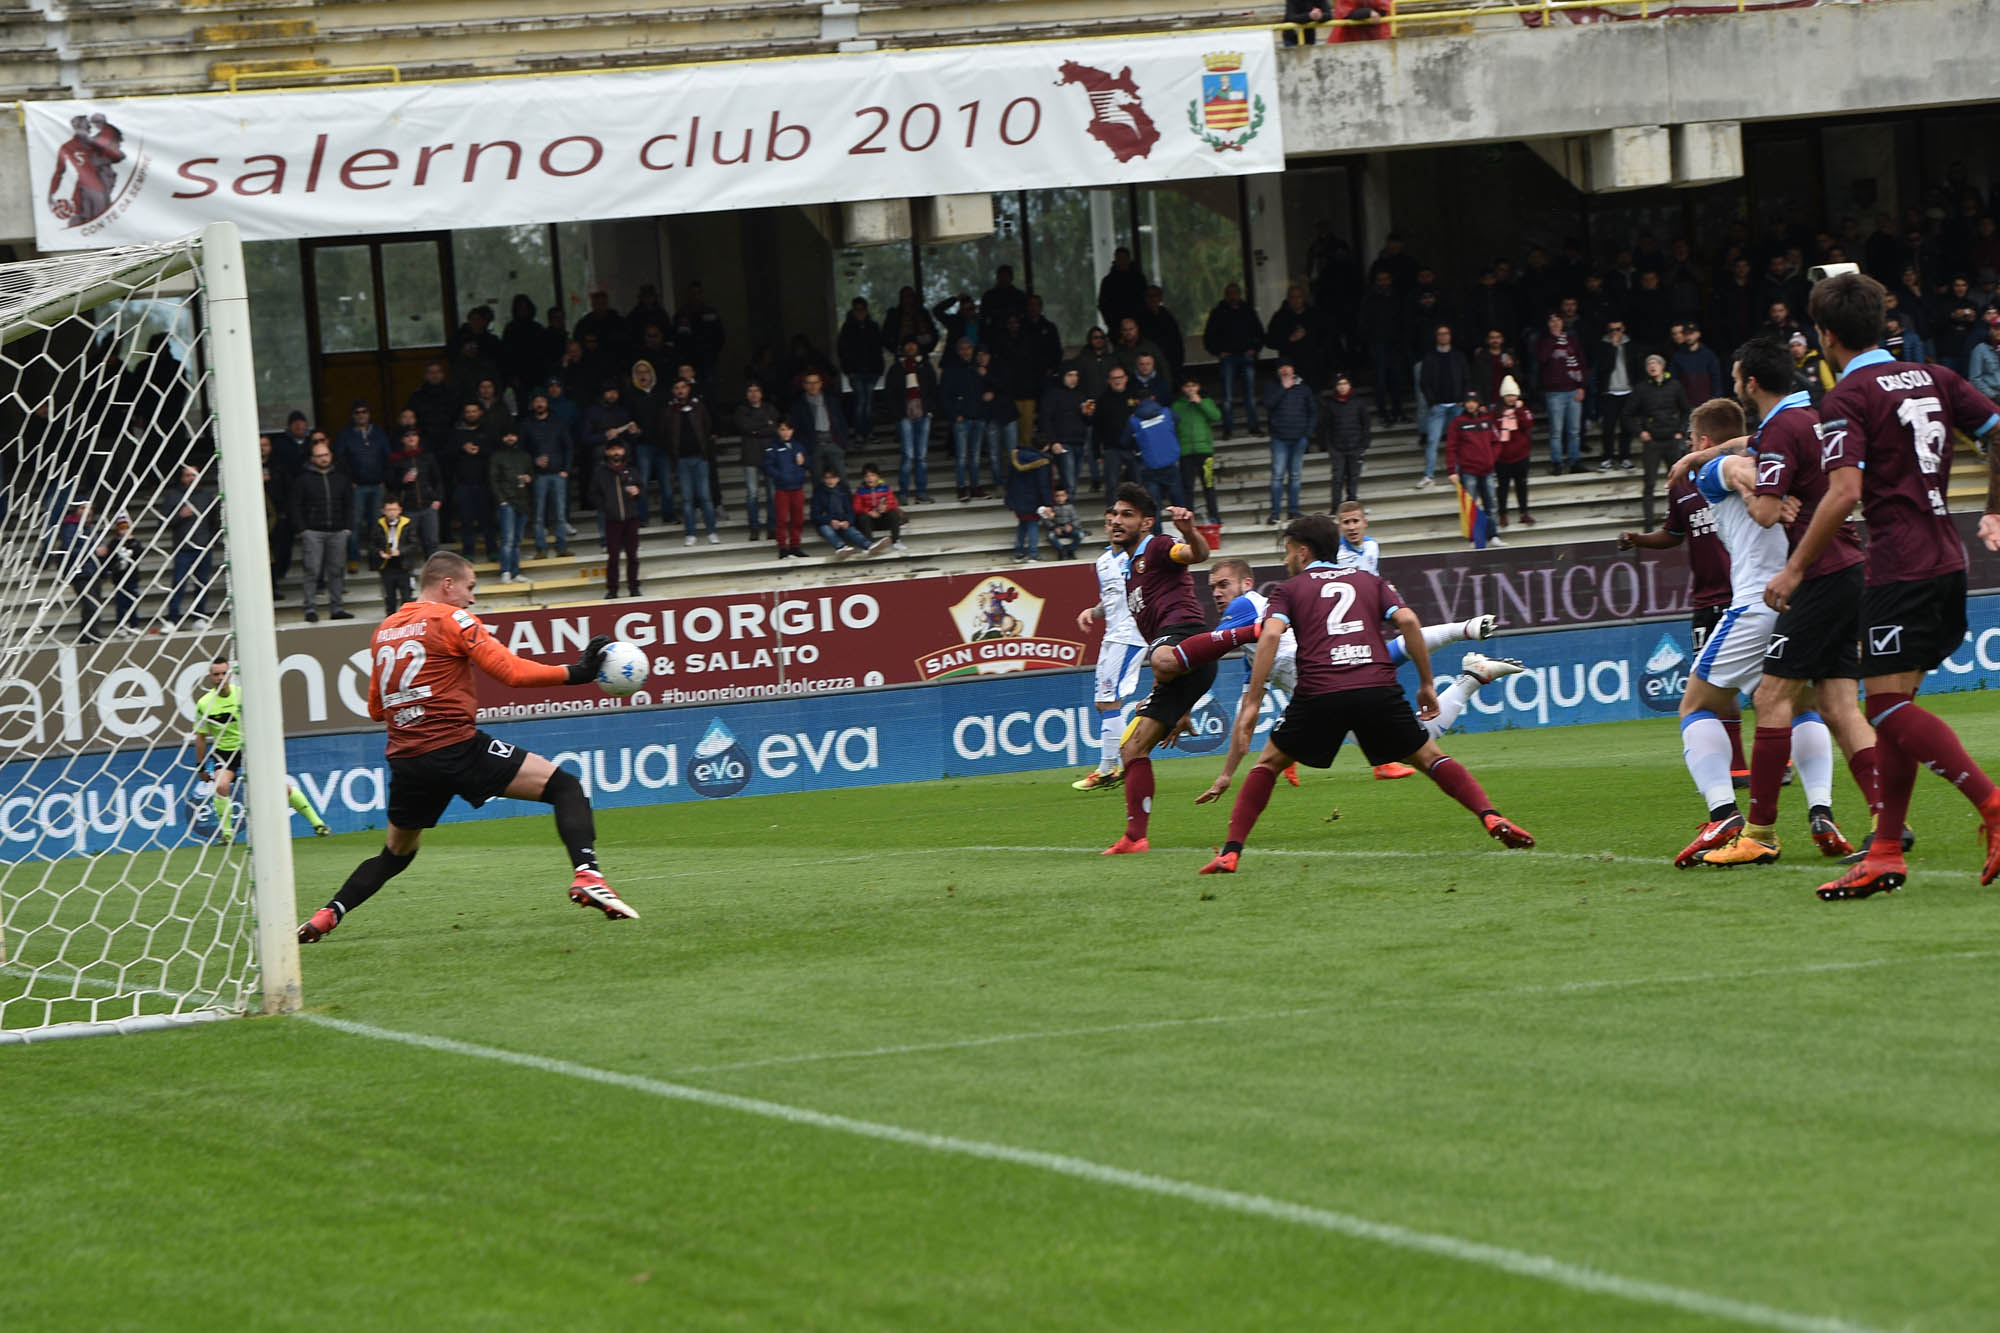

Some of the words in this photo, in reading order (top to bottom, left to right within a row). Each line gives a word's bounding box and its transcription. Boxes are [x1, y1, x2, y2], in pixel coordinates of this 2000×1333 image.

[171, 134, 604, 199] salerno
[640, 115, 811, 170] club
[848, 97, 1041, 155] 2010
[1897, 396, 1947, 475] 15
[613, 594, 880, 648] GIORGIO
[1320, 581, 1365, 636] 2
[376, 639, 433, 710] 22
[652, 656, 676, 675] &
[685, 645, 820, 673] SALATO
[925, 648, 974, 674] SAN
[979, 642, 1077, 661] GIORGIO
[1434, 659, 1630, 724] cqua
[757, 726, 879, 780] eva
[953, 701, 1138, 764] acqu
[284, 767, 387, 815] va
[551, 744, 678, 800] qua
[693, 755, 745, 783] eva
